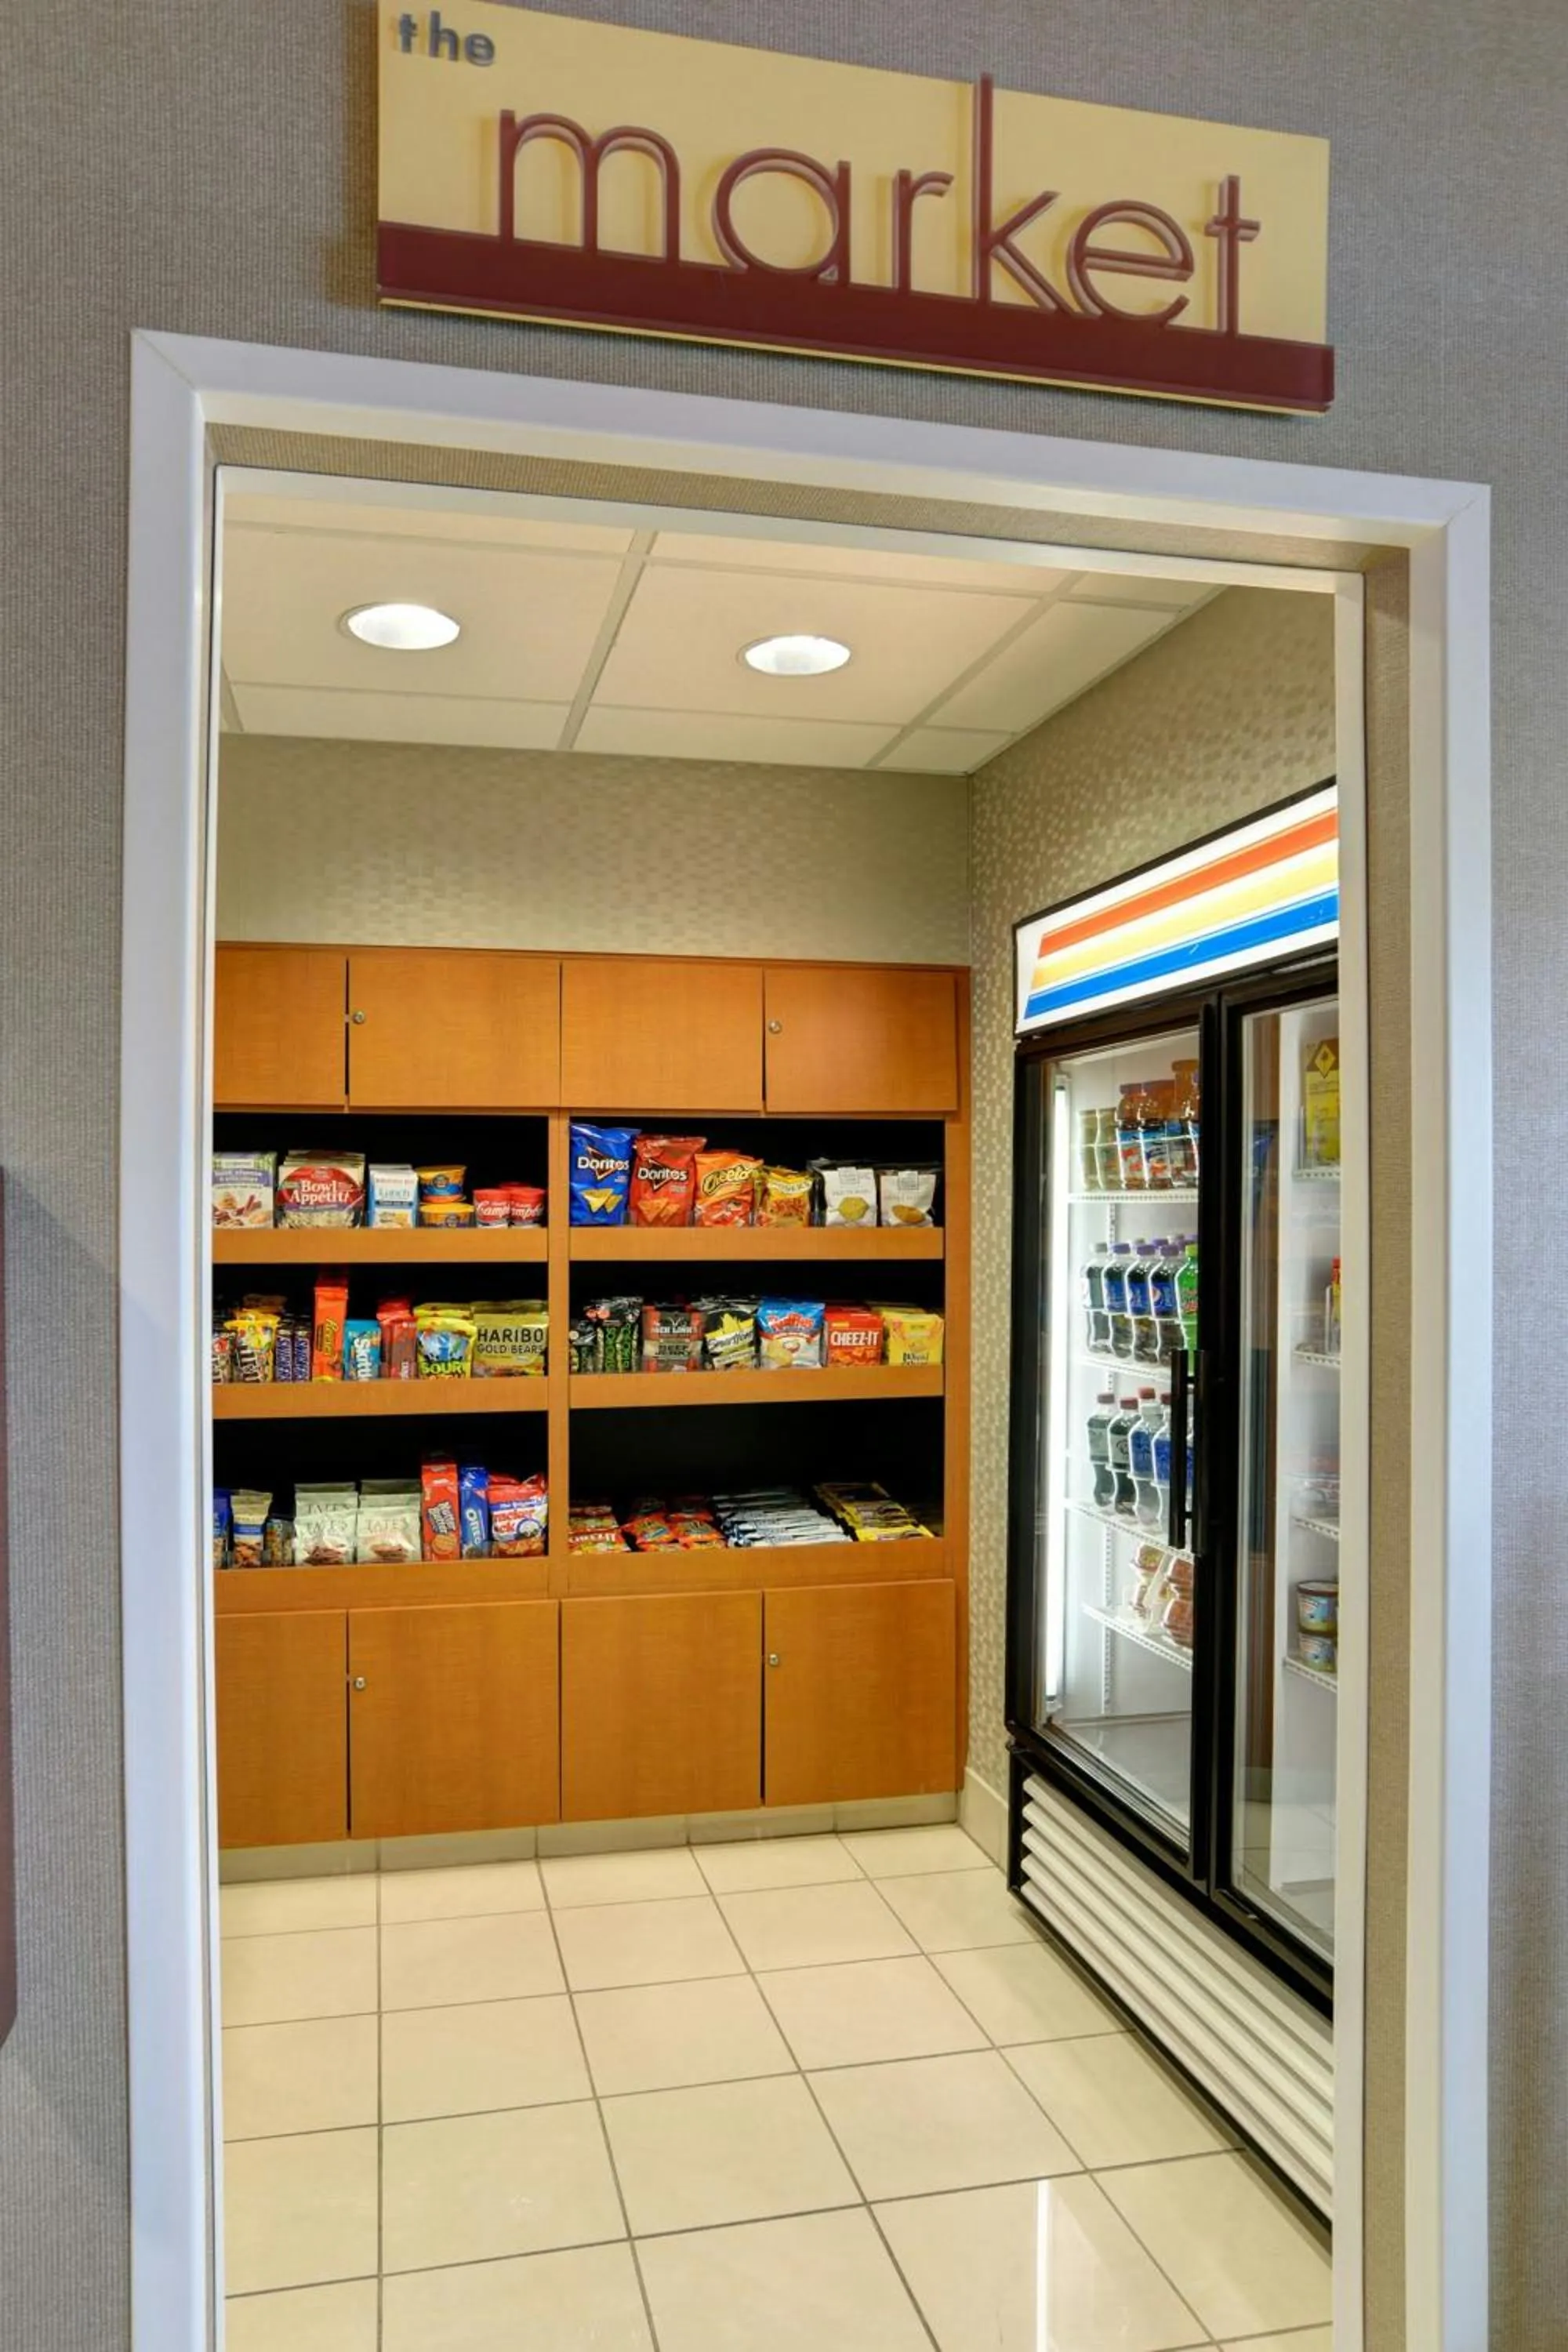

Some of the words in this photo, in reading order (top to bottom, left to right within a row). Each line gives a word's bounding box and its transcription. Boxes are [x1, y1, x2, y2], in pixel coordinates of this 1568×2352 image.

[397, 11, 496, 66] the
[497, 72, 1261, 337] market
[577, 1156, 629, 1170] Doritos
[637, 1168, 688, 1181] Doritos
[301, 1180, 338, 1192] Bowl
[477, 1328, 544, 1343] HARIBO
[830, 1332, 879, 1346] CHEEZ-IT
[477, 1343, 508, 1353] GOLD
[511, 1342, 543, 1353] BEARS
